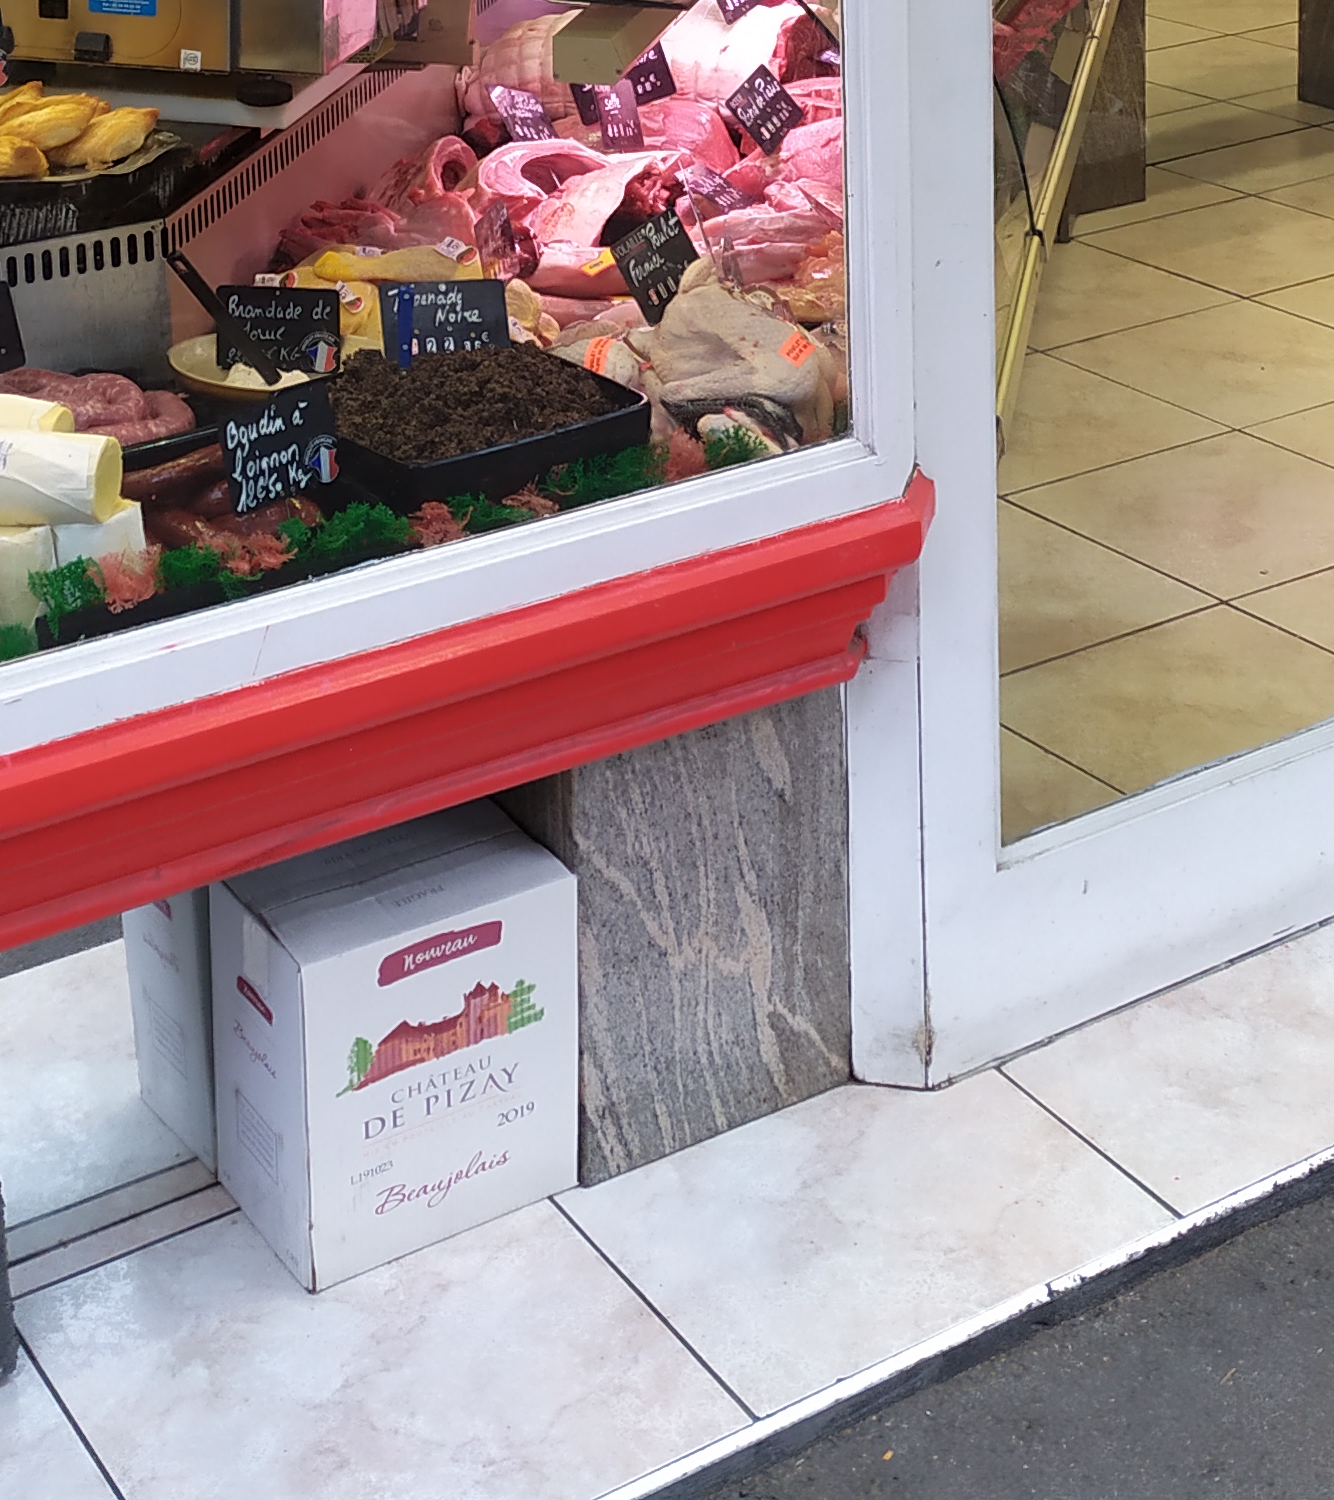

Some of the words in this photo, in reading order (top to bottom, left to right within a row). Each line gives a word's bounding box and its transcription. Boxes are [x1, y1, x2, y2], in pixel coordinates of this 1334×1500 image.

[228, 294, 303, 321] Brandade
[311, 298, 333, 321] de
[387, 285, 463, 314] Tpenade
[435, 305, 483, 328] Noire
[401, 932, 479, 973] Nouveau
[390, 1054, 492, 1105] CHÂTEAU
[362, 1106, 406, 1141] DE
[424, 1061, 520, 1118] PIZAY
[496, 1100, 536, 1128] 2019
[373, 1149, 512, 1217] Beaujolais
